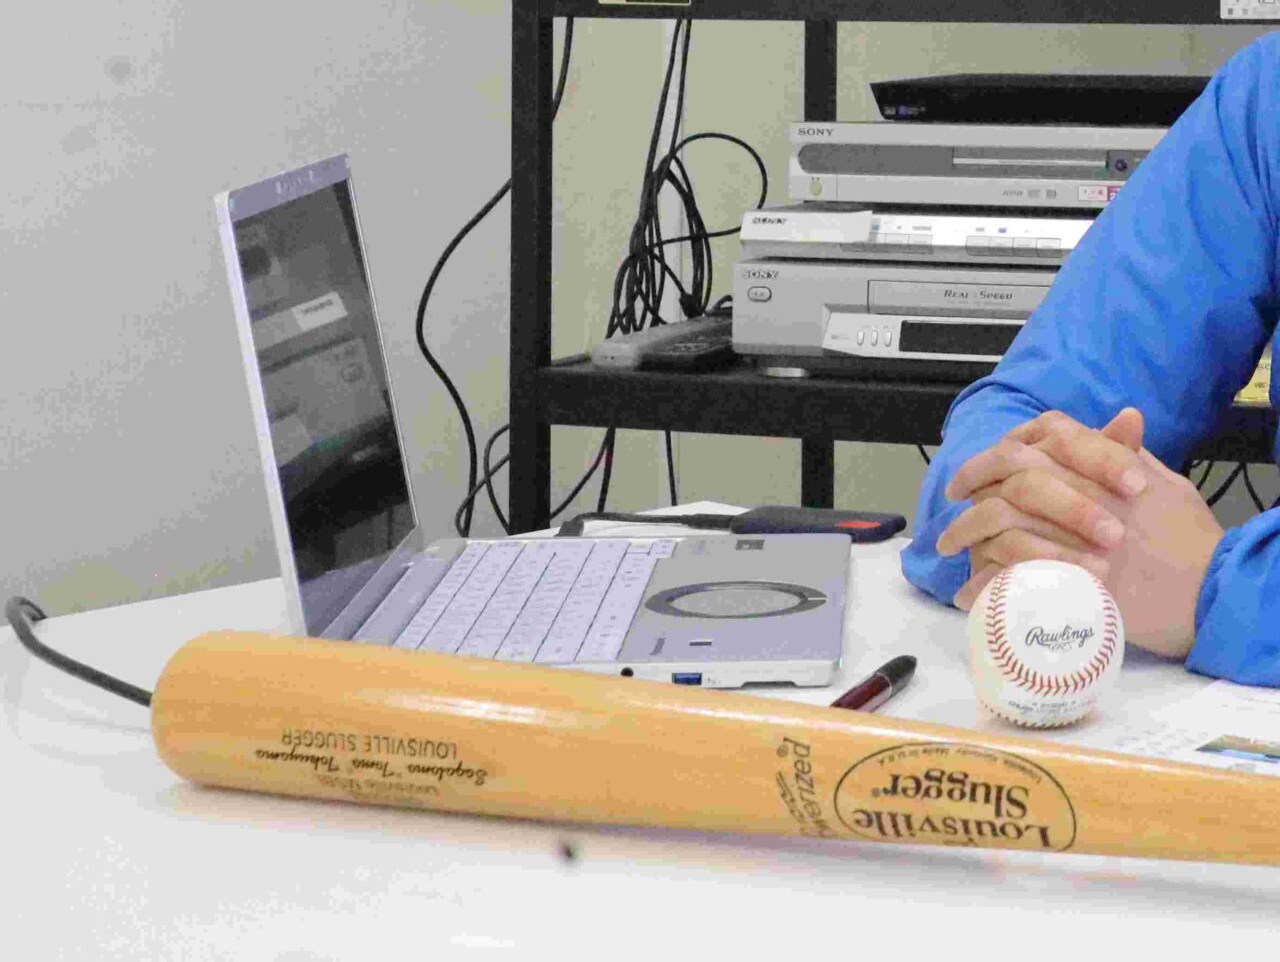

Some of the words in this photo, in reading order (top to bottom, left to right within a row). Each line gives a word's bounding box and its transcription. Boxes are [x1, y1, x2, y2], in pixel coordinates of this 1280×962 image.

[797, 127, 835, 137] SONY
[743, 269, 781, 280] SONY
[1025, 625, 1096, 649] Rawlings
[280, 727, 357, 752] SLUGGER
[363, 735, 458, 760] LOUISVILLE
[851, 807, 1051, 851] Louisville
